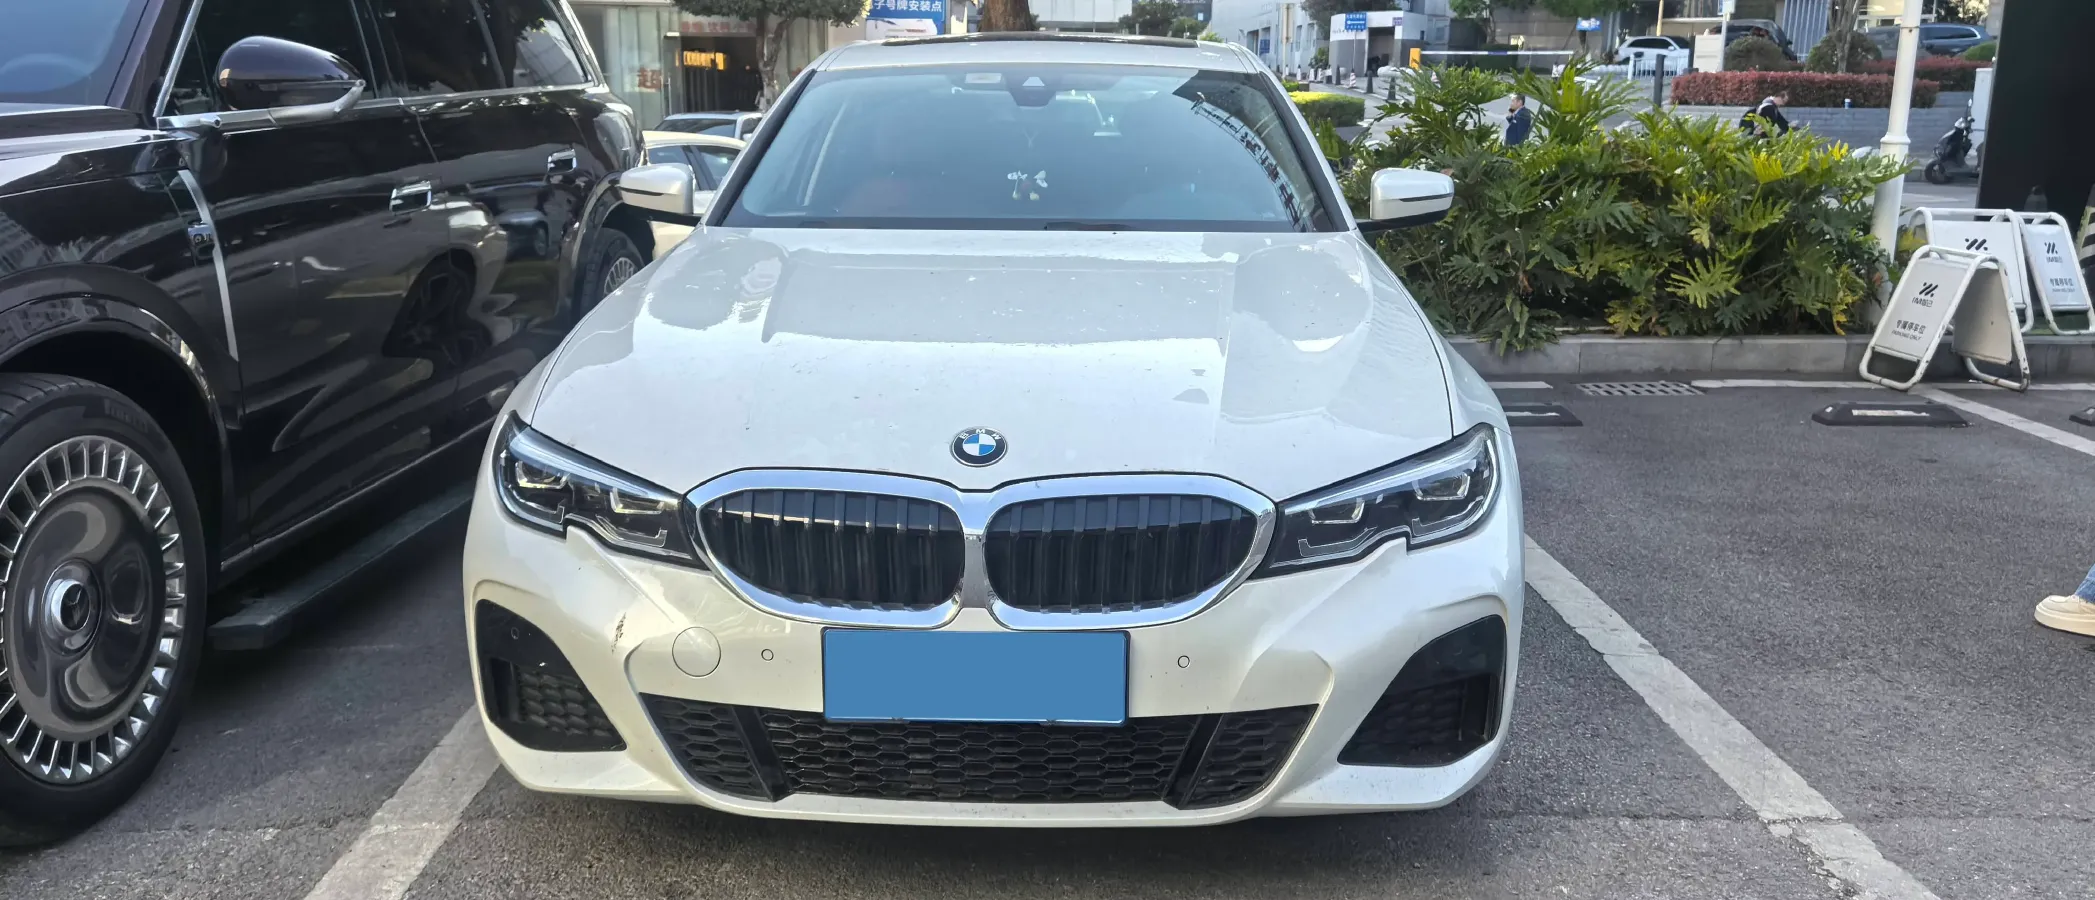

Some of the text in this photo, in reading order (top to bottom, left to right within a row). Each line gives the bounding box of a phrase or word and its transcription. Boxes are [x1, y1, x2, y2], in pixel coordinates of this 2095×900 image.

[871, 0, 942, 12] 子号牌安装点
[959, 428, 1001, 440] BMW
